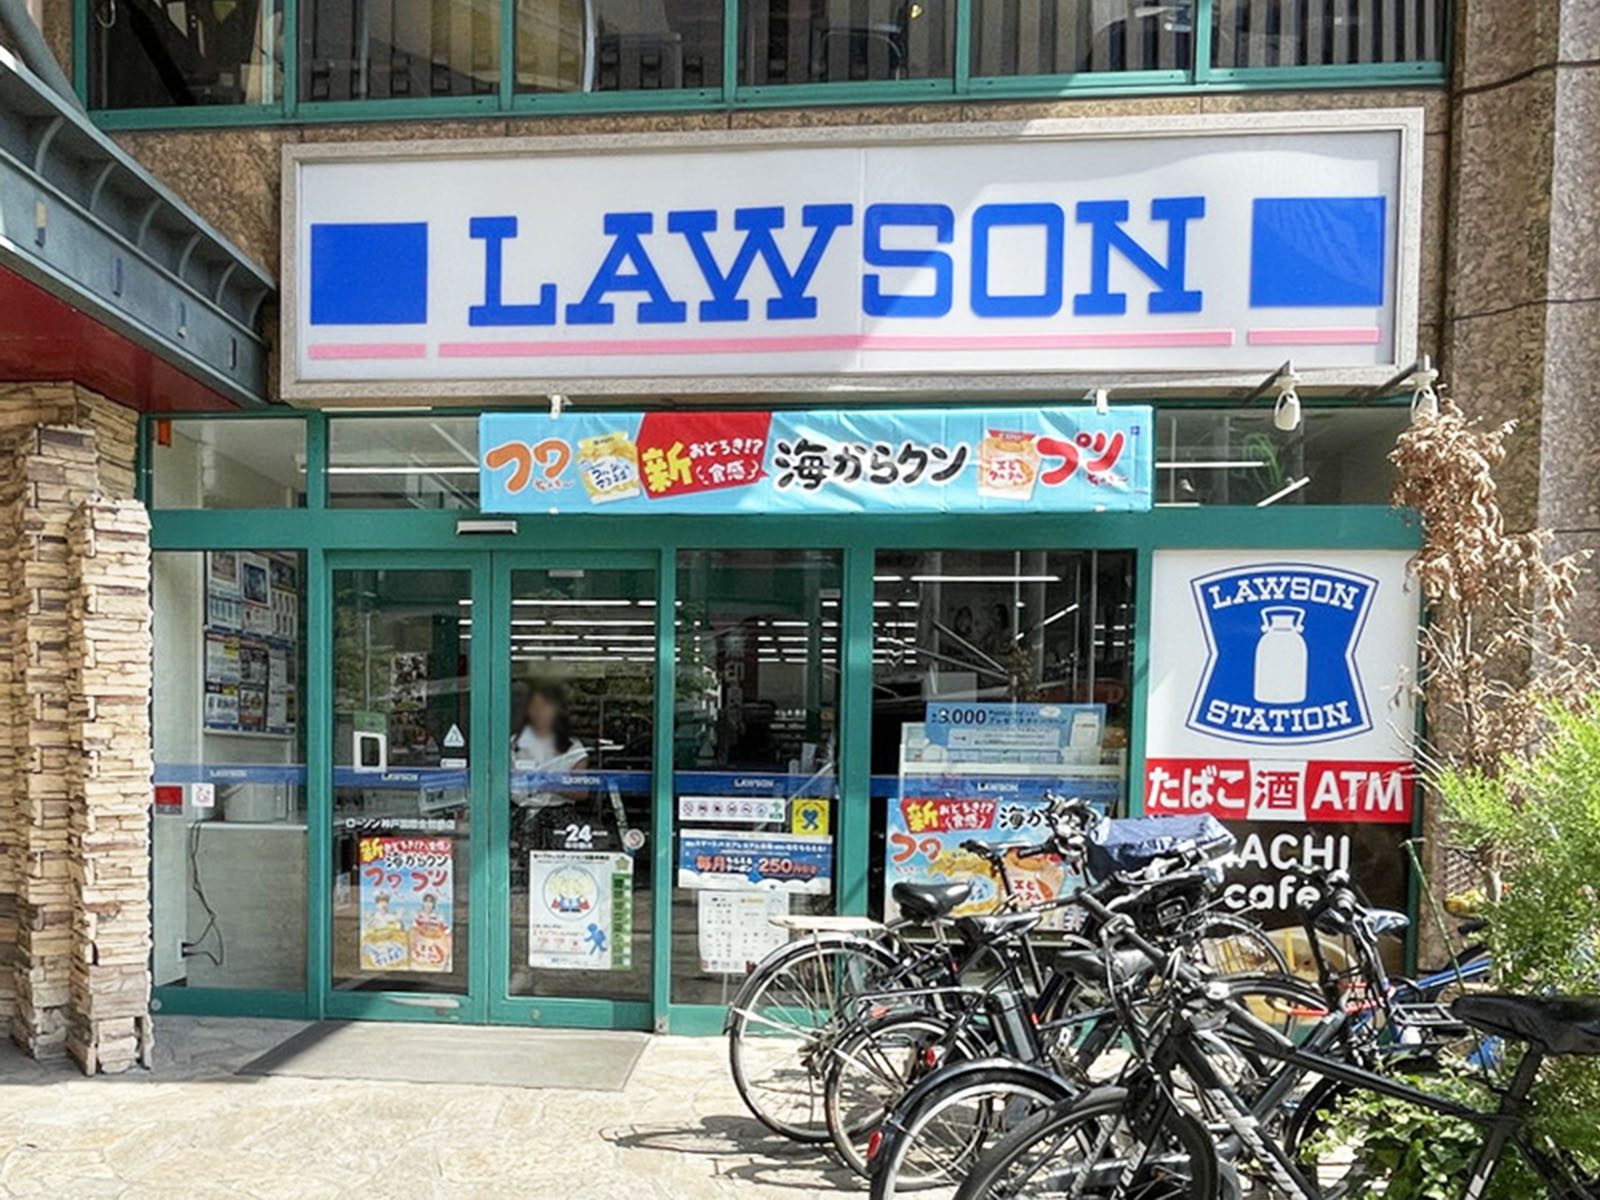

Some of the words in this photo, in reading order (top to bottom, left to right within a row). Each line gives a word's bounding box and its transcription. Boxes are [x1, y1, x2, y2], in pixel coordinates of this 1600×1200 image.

[469, 197, 1205, 326] LAWSON
[642, 441, 693, 492] 新
[775, 439, 967, 490] 海からクン
[1208, 576, 1360, 610] LAWSON
[1206, 700, 1353, 732] STATION
[1148, 765, 1245, 809] たばこ
[1256, 770, 1300, 810] 酒
[1311, 770, 1405, 812] ATM
[565, 823, 592, 842] 24
[907, 801, 938, 831] 新
[758, 857, 792, 873] 250
[1228, 833, 1350, 872] ACHI
